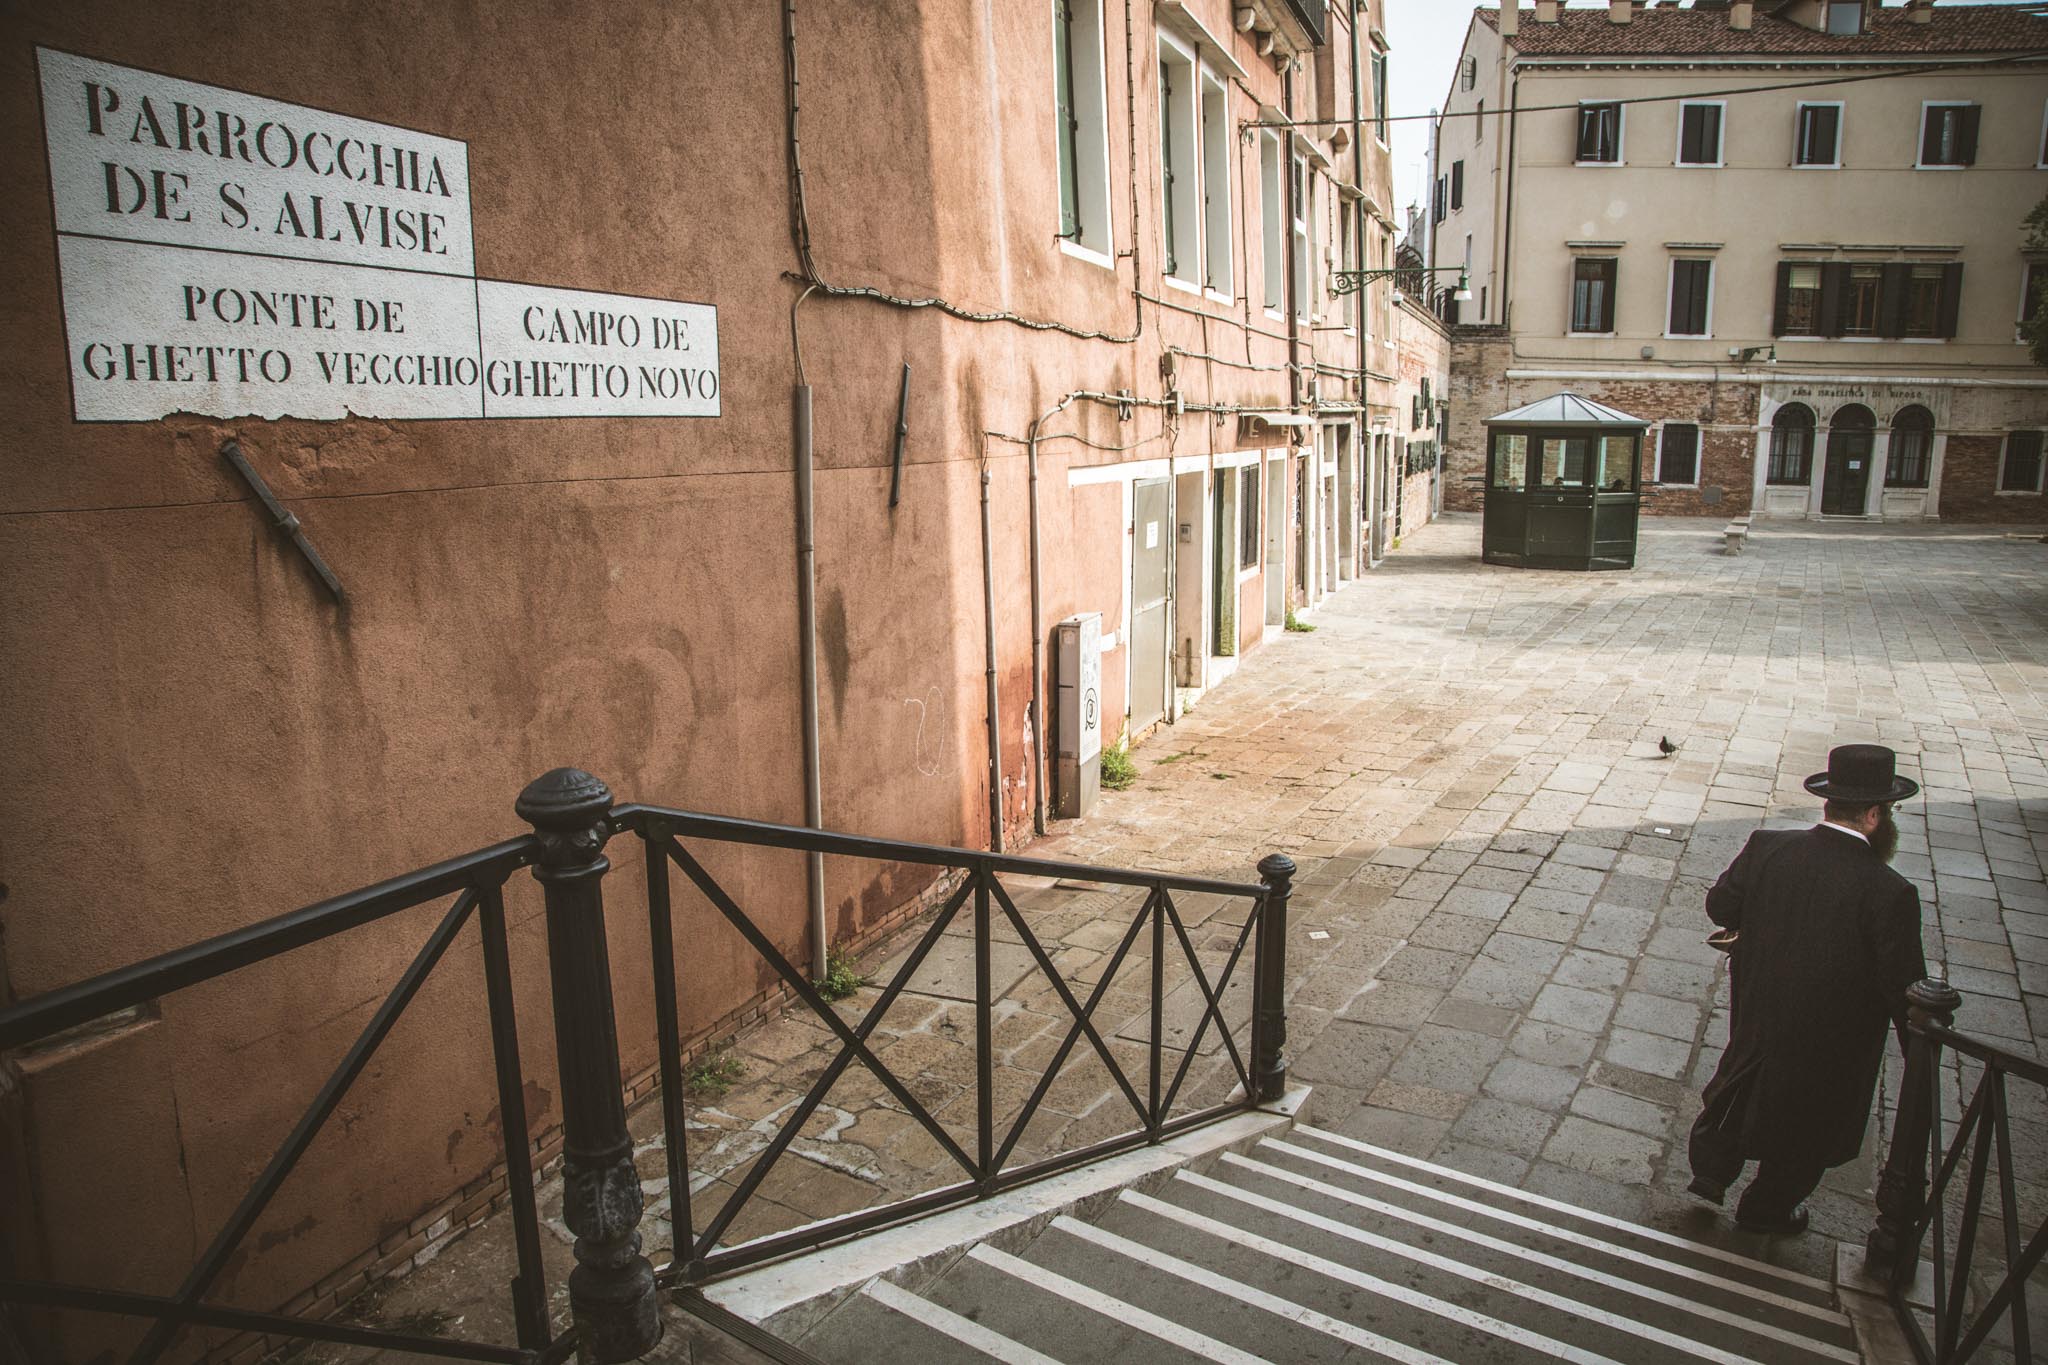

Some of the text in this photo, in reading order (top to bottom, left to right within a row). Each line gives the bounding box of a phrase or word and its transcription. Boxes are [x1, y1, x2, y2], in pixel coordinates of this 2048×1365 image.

[82, 81, 452, 197] PARROCCHIA
[101, 161, 191, 222] DE
[274, 191, 447, 255] ALVISE
[182, 285, 404, 333] PONTE DE
[522, 305, 690, 351] CAMPO DE
[82, 342, 479, 387] GHETTO VECCHIO
[486, 358, 718, 399] GHETTO NOVO
